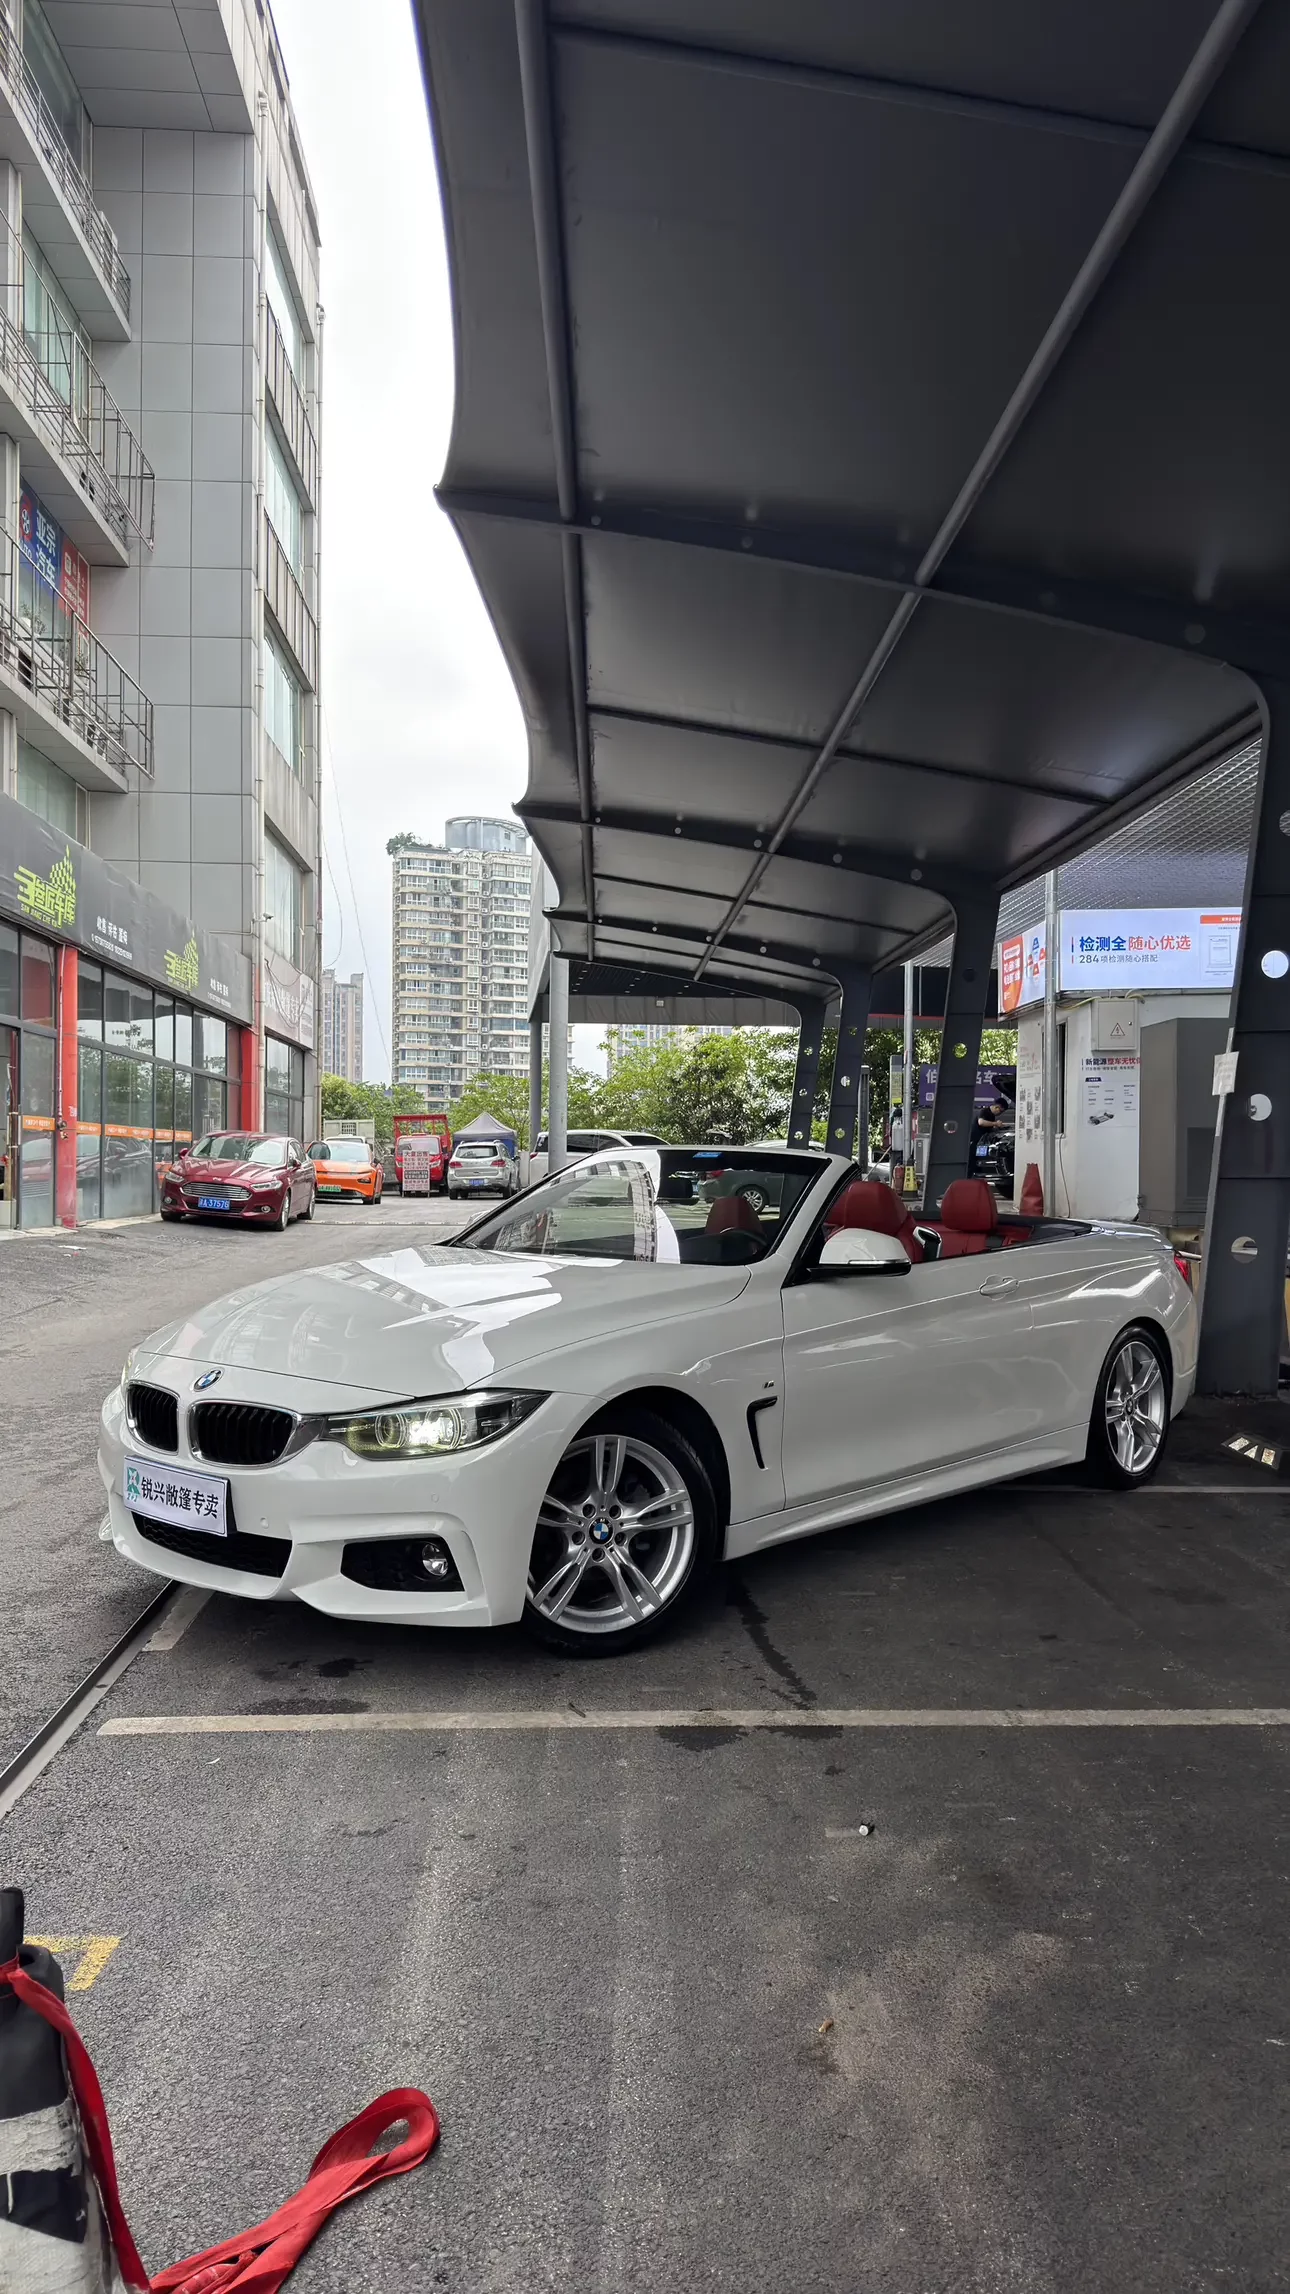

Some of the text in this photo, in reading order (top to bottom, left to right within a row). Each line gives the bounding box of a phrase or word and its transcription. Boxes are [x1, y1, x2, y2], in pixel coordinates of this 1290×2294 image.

[36, 509, 56, 557] 亚宗
[36, 544, 56, 588] 汽车
[1079, 935, 1192, 952] 检测全随心优选
[1079, 954, 1158, 964] 284项检测随心搭配
[141, 1477, 219, 1519] 锐兴敞篷专卖
